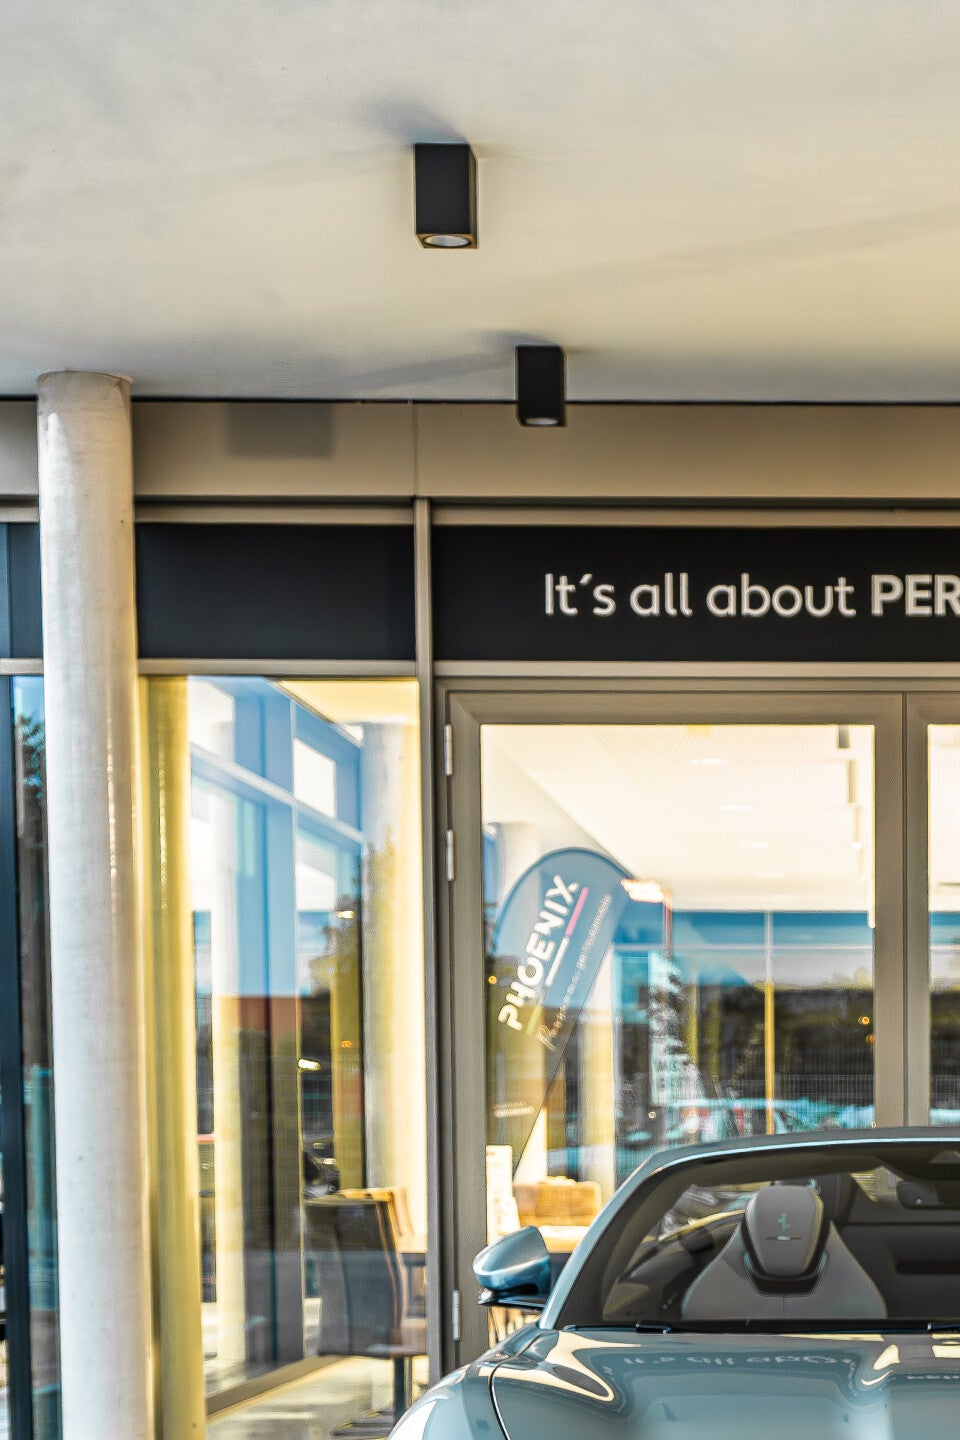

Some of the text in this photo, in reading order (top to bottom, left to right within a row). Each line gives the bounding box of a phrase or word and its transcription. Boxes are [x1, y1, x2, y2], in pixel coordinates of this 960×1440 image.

[629, 572, 693, 617] all
[706, 572, 857, 617] about
[498, 874, 580, 1031] PHOENIX
